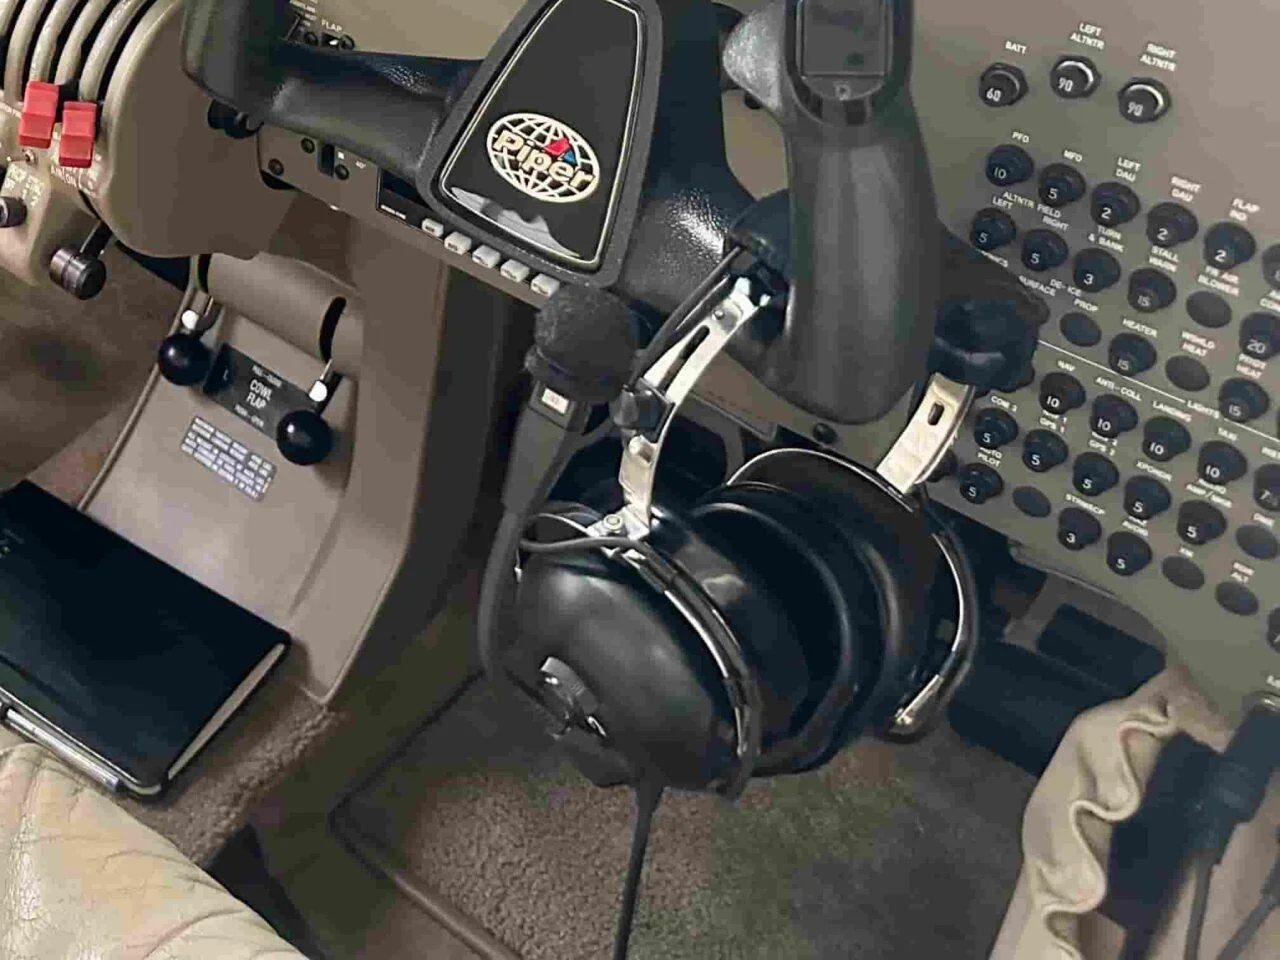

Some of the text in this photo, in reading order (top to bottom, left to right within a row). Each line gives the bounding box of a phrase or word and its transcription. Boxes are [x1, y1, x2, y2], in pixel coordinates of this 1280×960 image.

[321, 18, 343, 32] FLAP
[1079, 22, 1102, 37] LEFT
[1005, 40, 1028, 55] BATT
[1058, 77, 1074, 93] 90
[986, 88, 1002, 102] 60
[1011, 131, 1031, 144] PFD
[493, 128, 598, 188] Piper
[1063, 149, 1084, 163] MFD
[1117, 156, 1142, 172] LEFT
[993, 167, 1008, 180] 10
[1048, 188, 1059, 201] 5
[992, 196, 1015, 211] LEFT
[1002, 191, 1062, 219] ALTNTR FIELD
[1101, 206, 1113, 220] 2
[1042, 215, 1071, 232] RIGHT
[979, 232, 989, 244] 5
[1157, 228, 1169, 241] 2
[1030, 253, 1041, 265] 5
[1151, 245, 1180, 262] STALL
[1214, 249, 1227, 263] 2
[1083, 273, 1095, 286] 3
[1073, 298, 1100, 313] PROP
[1137, 295, 1152, 308] 15
[1122, 318, 1158, 339] HEATER
[1247, 338, 1266, 355] 20
[1117, 357, 1130, 371] 15
[250, 379, 272, 402] COWL
[246, 391, 267, 409] FLAP
[1046, 395, 1061, 409] 10
[1228, 403, 1242, 417] 15
[1096, 418, 1112, 432] 10
[982, 432, 992, 444] 5
[1149, 441, 1165, 455] 10
[1031, 454, 1041, 466] 5
[1205, 464, 1221, 478] 10
[1082, 477, 1093, 490] 5
[967, 486, 977, 498] 5
[1133, 501, 1144, 513] 5
[1066, 532, 1076, 544] 3
[1186, 525, 1197, 538] 5
[1116, 558, 1126, 570] 5
